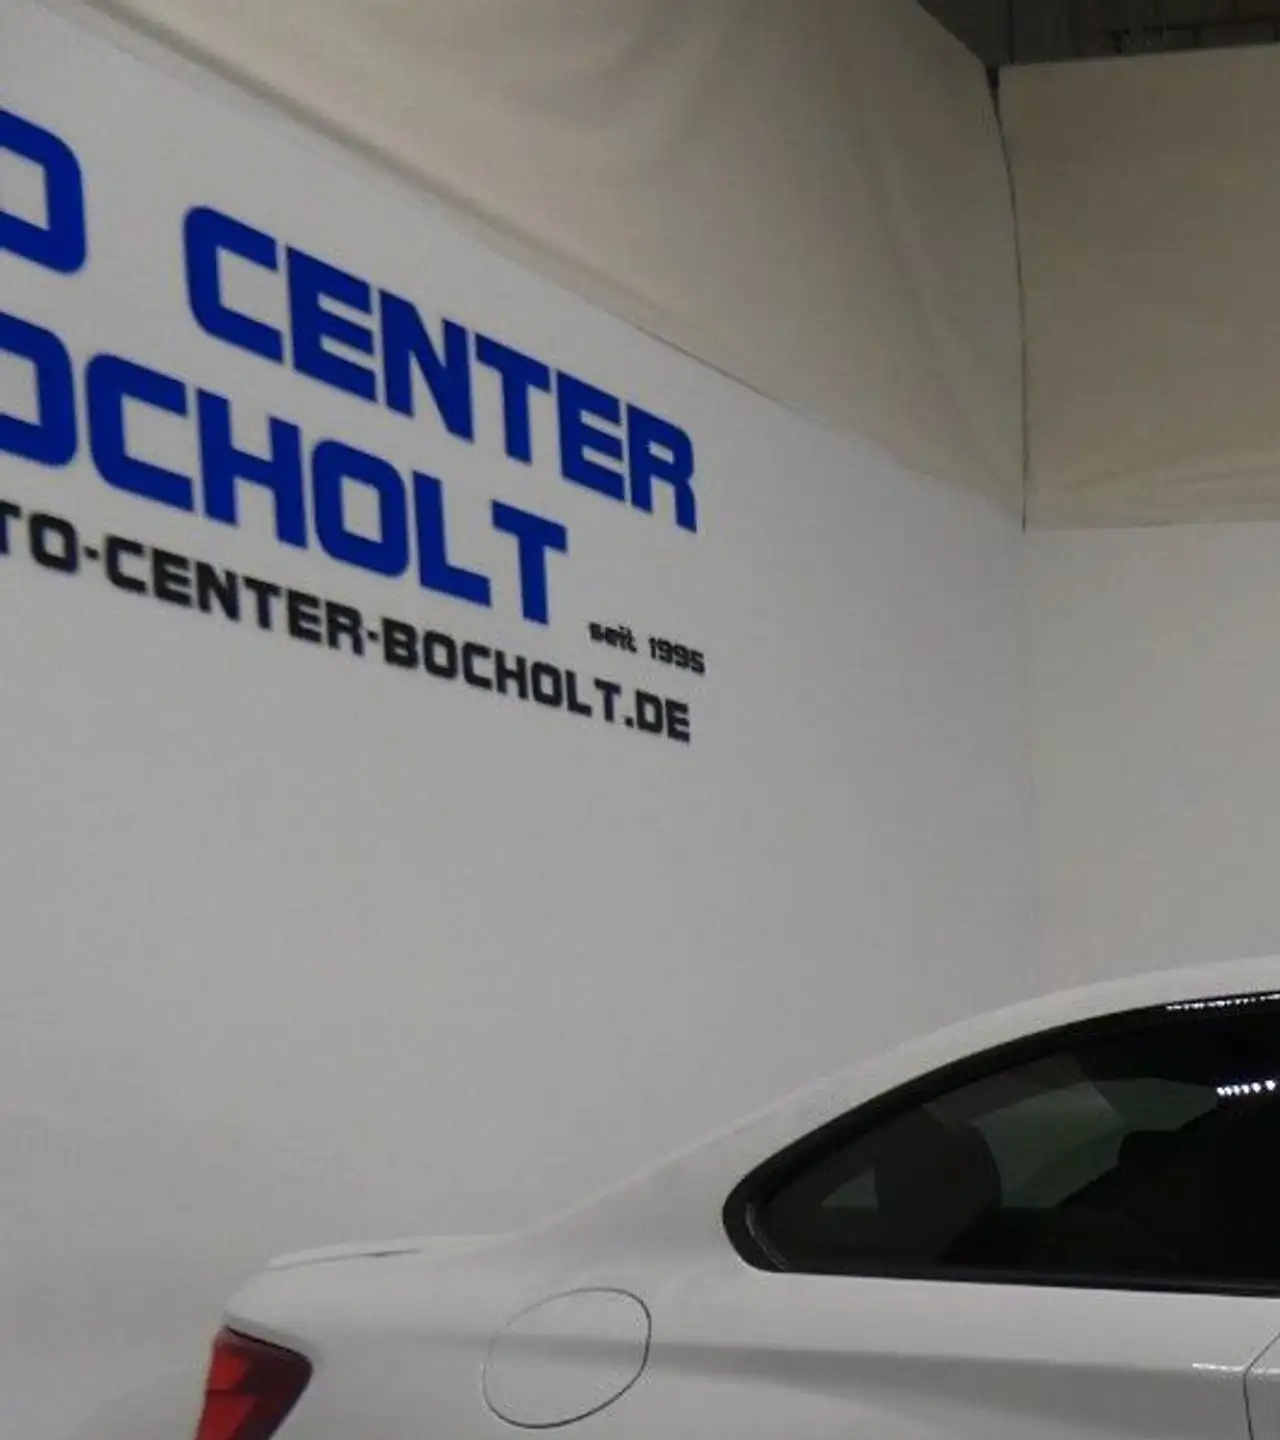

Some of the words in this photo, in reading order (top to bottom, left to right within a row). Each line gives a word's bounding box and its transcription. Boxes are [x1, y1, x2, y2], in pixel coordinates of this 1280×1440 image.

[182, 205, 698, 534] CENTER
[588, 621, 639, 655] seit
[648, 635, 706, 677] 1995
